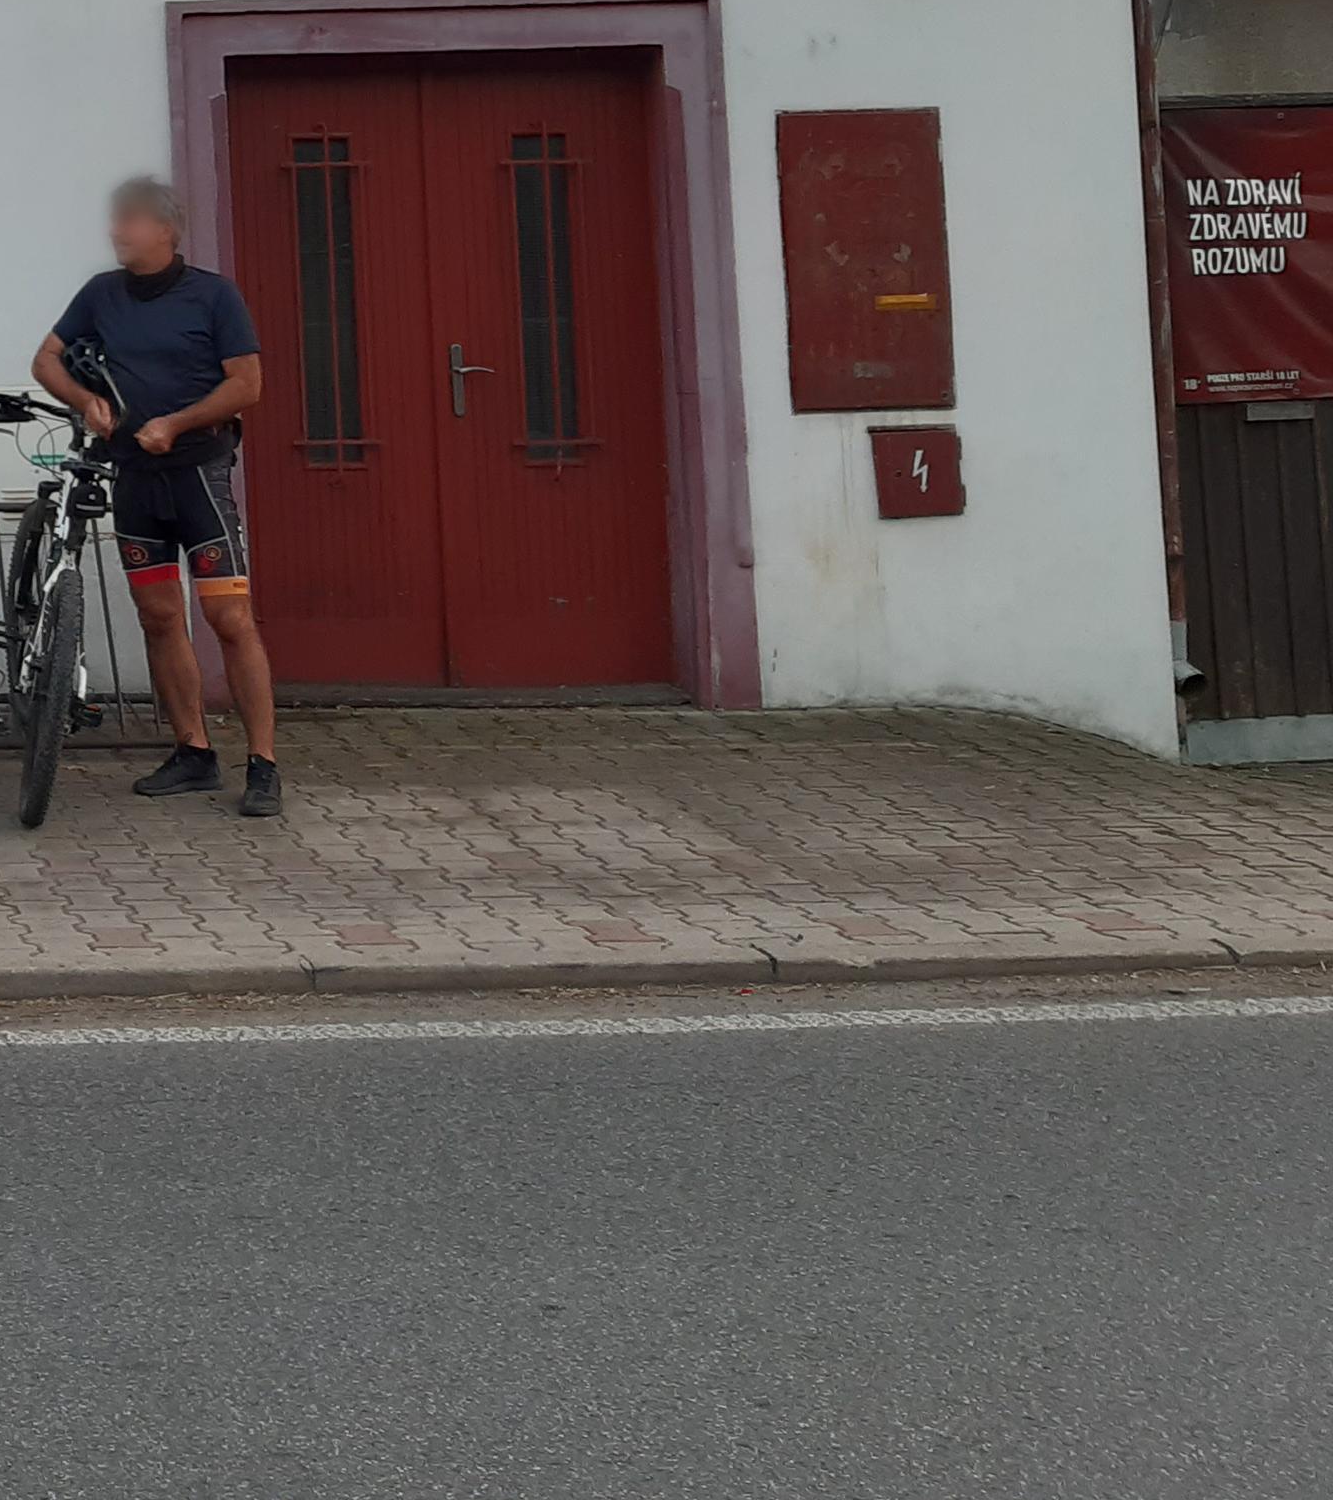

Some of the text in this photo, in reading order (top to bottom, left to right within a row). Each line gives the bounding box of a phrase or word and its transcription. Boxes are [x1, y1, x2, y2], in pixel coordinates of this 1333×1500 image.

[1186, 171, 1303, 206] NA ZDRAVÍ
[1189, 206, 1307, 240] ZDRAVÉMU
[1191, 246, 1286, 275] ROZUMU
[1287, 371, 1300, 380] LET
